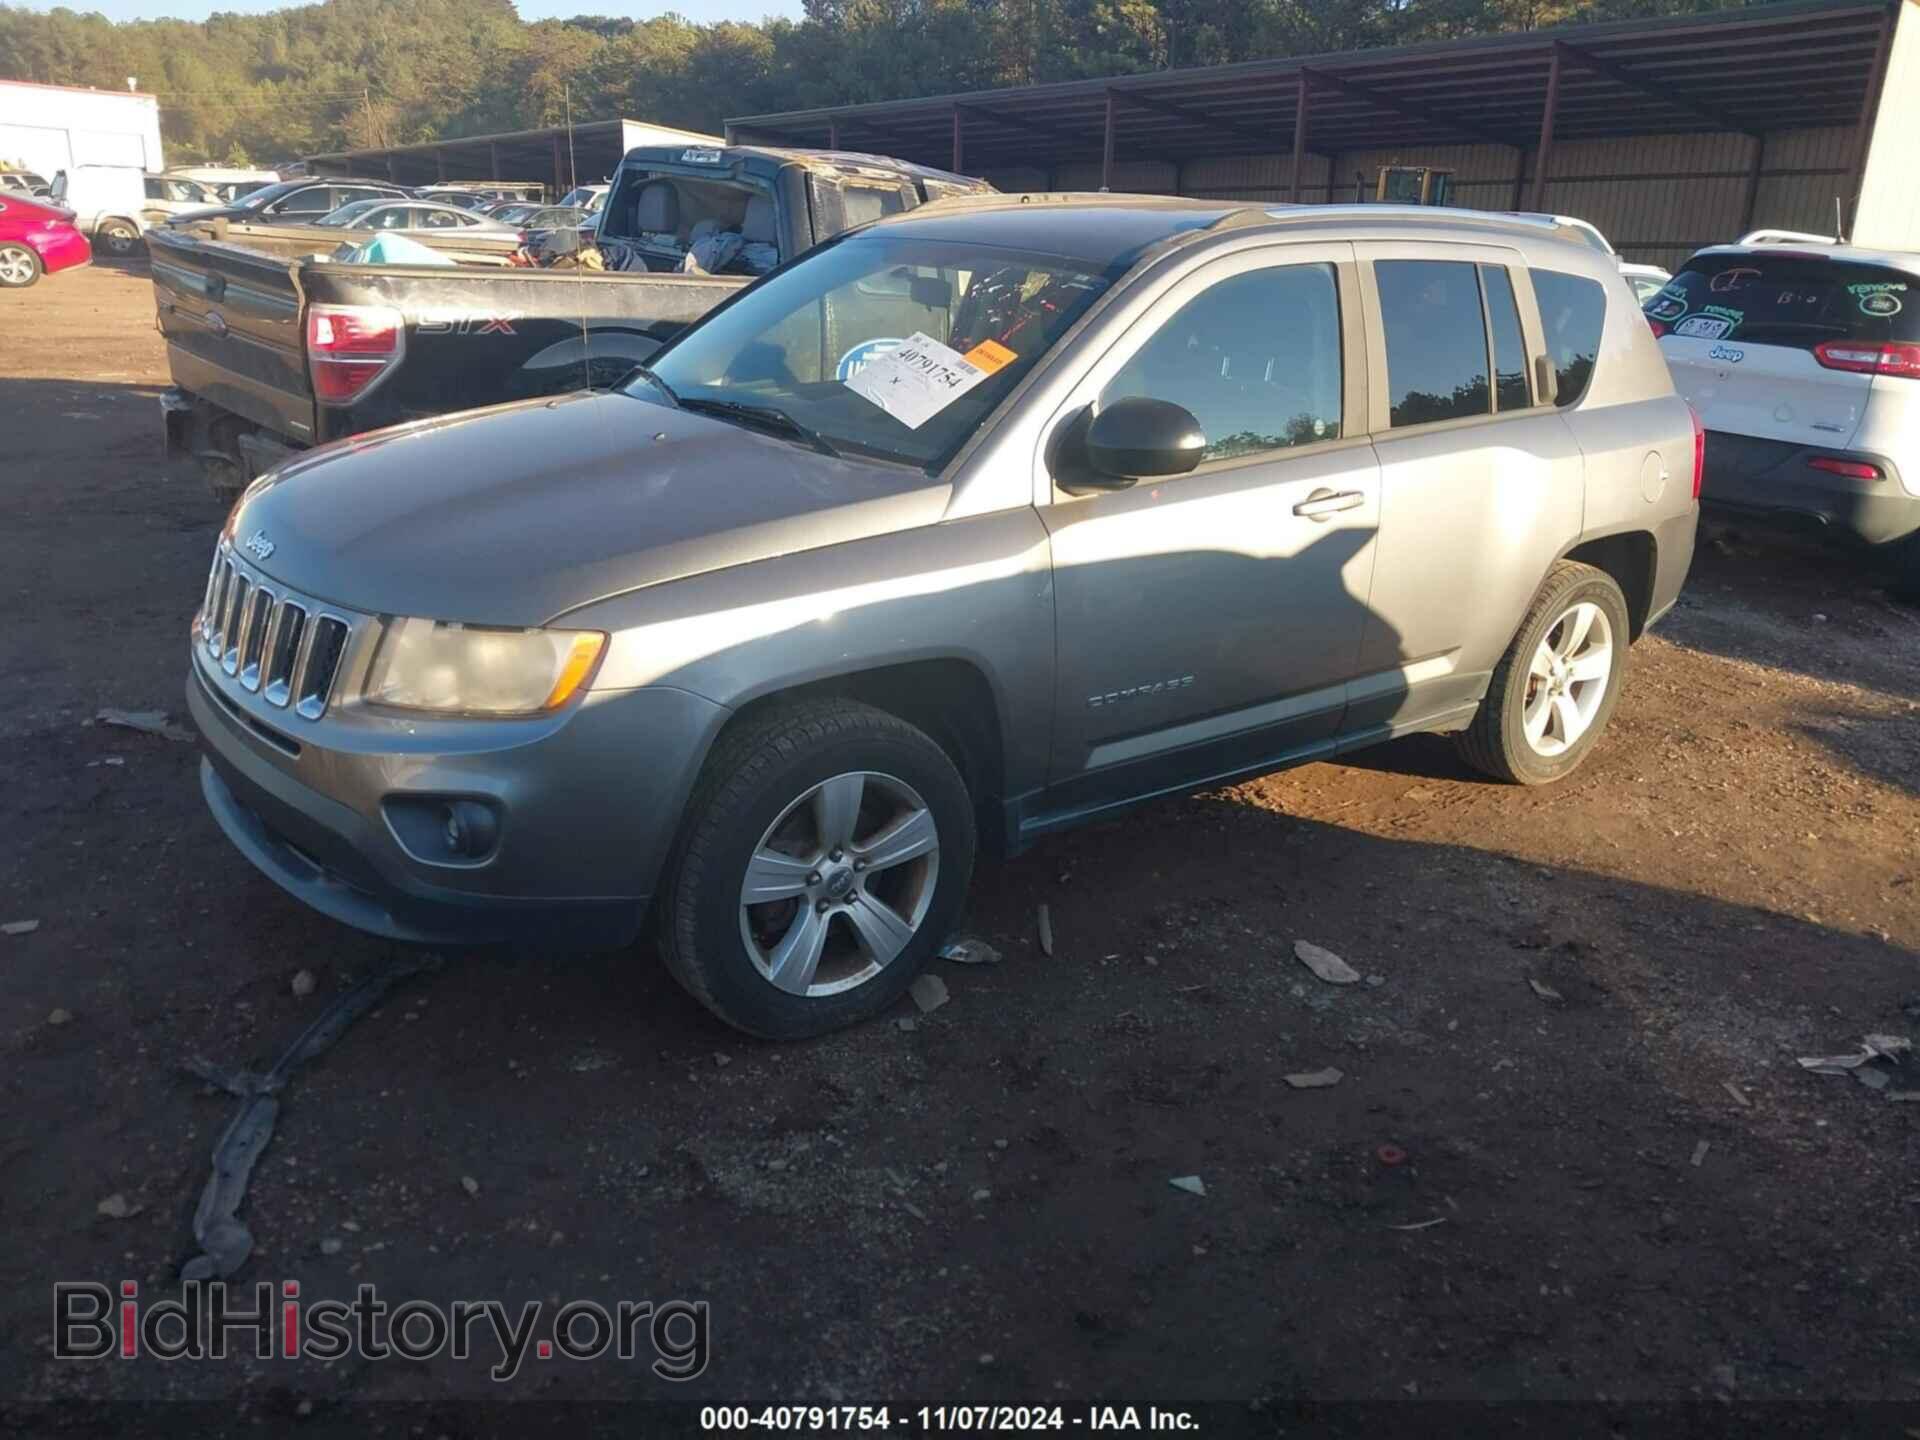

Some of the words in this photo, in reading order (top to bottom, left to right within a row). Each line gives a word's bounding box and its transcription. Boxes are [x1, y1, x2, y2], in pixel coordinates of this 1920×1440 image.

[897, 348, 964, 389] 40791754
[1708, 344, 1744, 363] Jeep
[245, 529, 275, 561] Jeep
